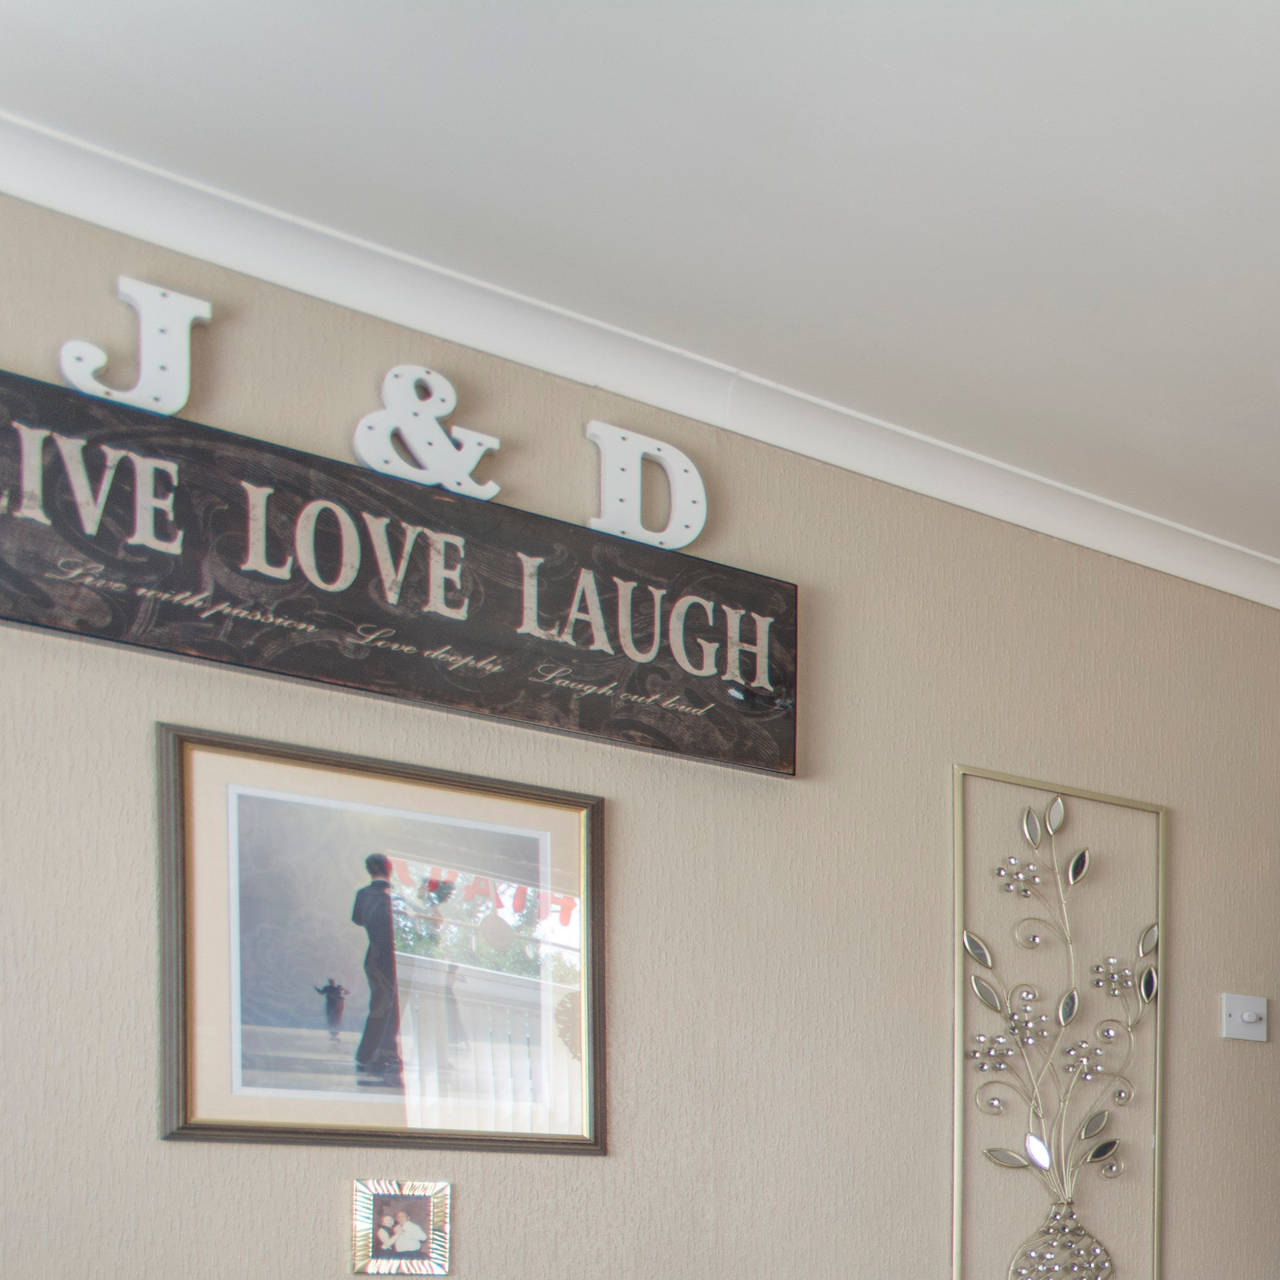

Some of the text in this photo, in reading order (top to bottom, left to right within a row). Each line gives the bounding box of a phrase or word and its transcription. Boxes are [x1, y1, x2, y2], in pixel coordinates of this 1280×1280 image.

[60, 276, 707, 550] J & D
[0, 420, 774, 692] IVE LOVE LAUGH
[44, 557, 320, 634] Live with passion
[355, 623, 504, 676] Love deeply
[528, 663, 617, 701] Laugh
[659, 694, 714, 717] loud
